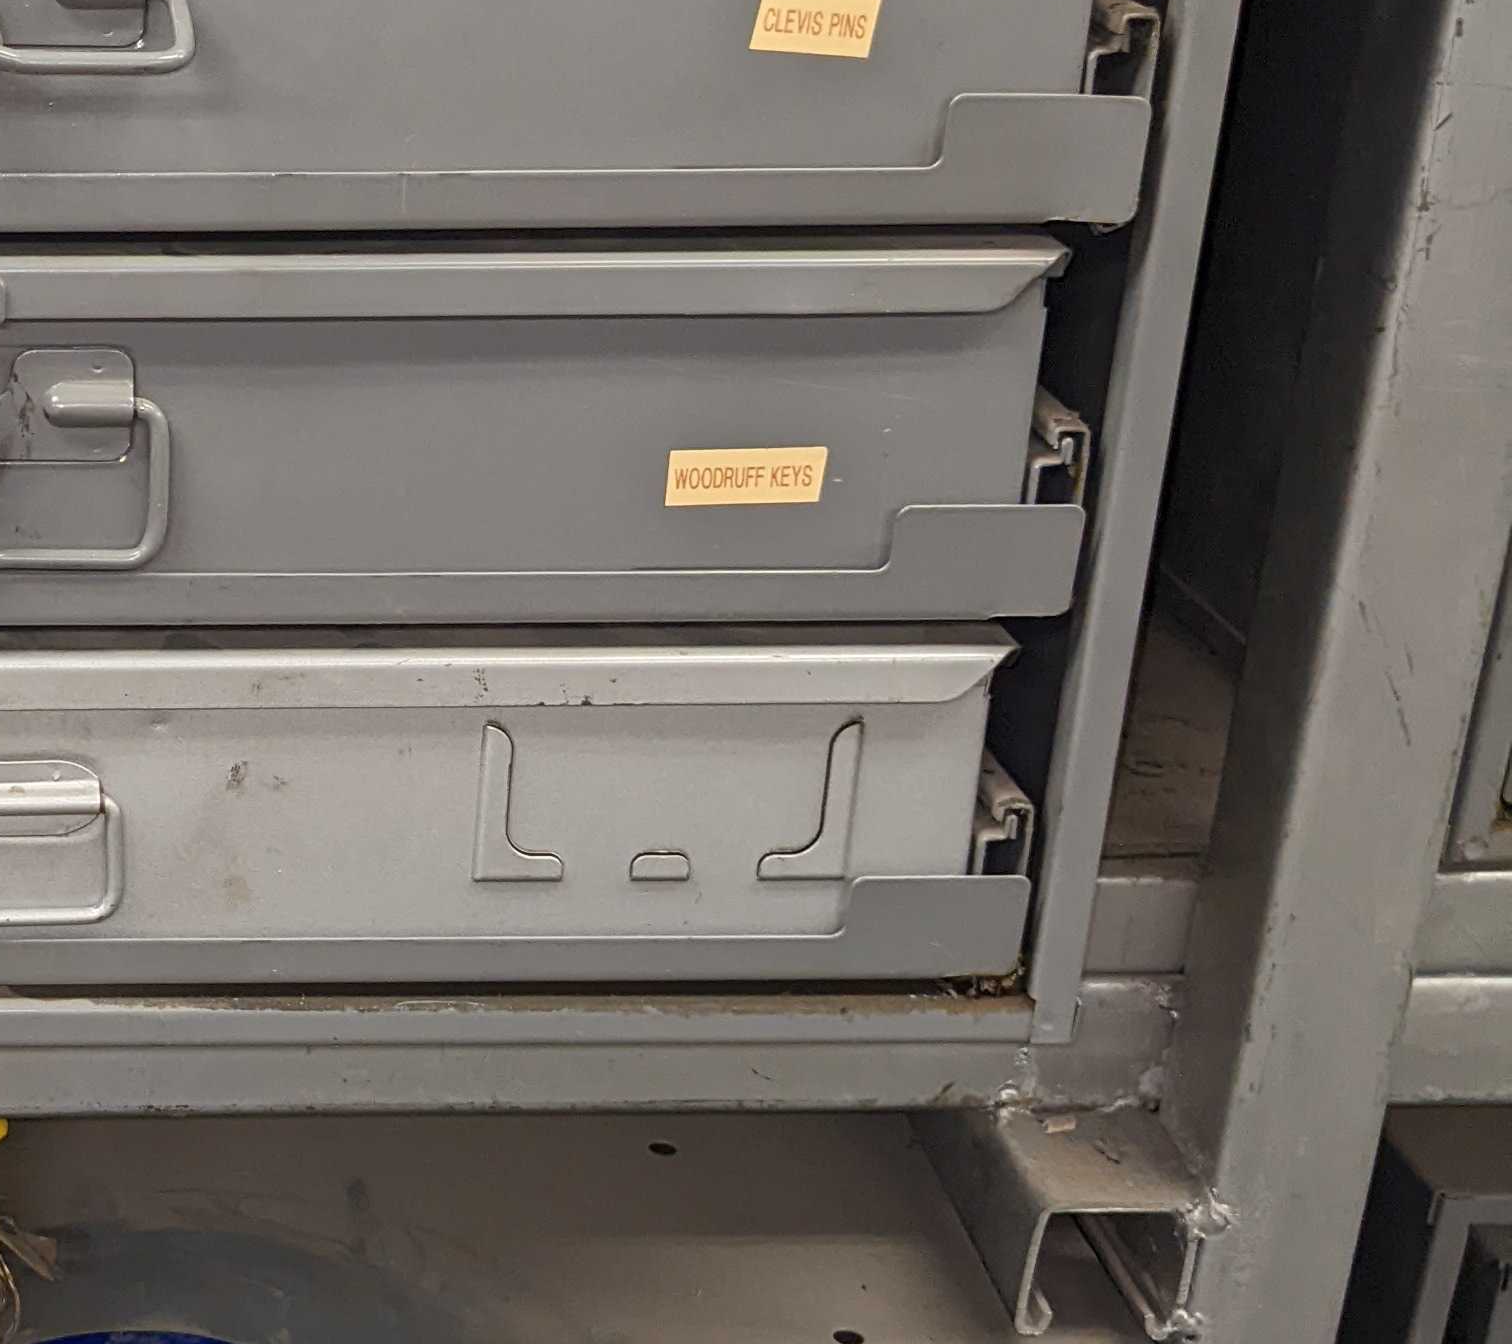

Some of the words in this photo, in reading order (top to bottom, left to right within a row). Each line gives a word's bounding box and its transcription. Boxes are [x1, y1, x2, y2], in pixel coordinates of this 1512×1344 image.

[763, 8, 824, 36] CLEVIS
[828, 12, 868, 39] PINS
[674, 466, 766, 490] WOODRUFF
[769, 464, 814, 488] KEYS
